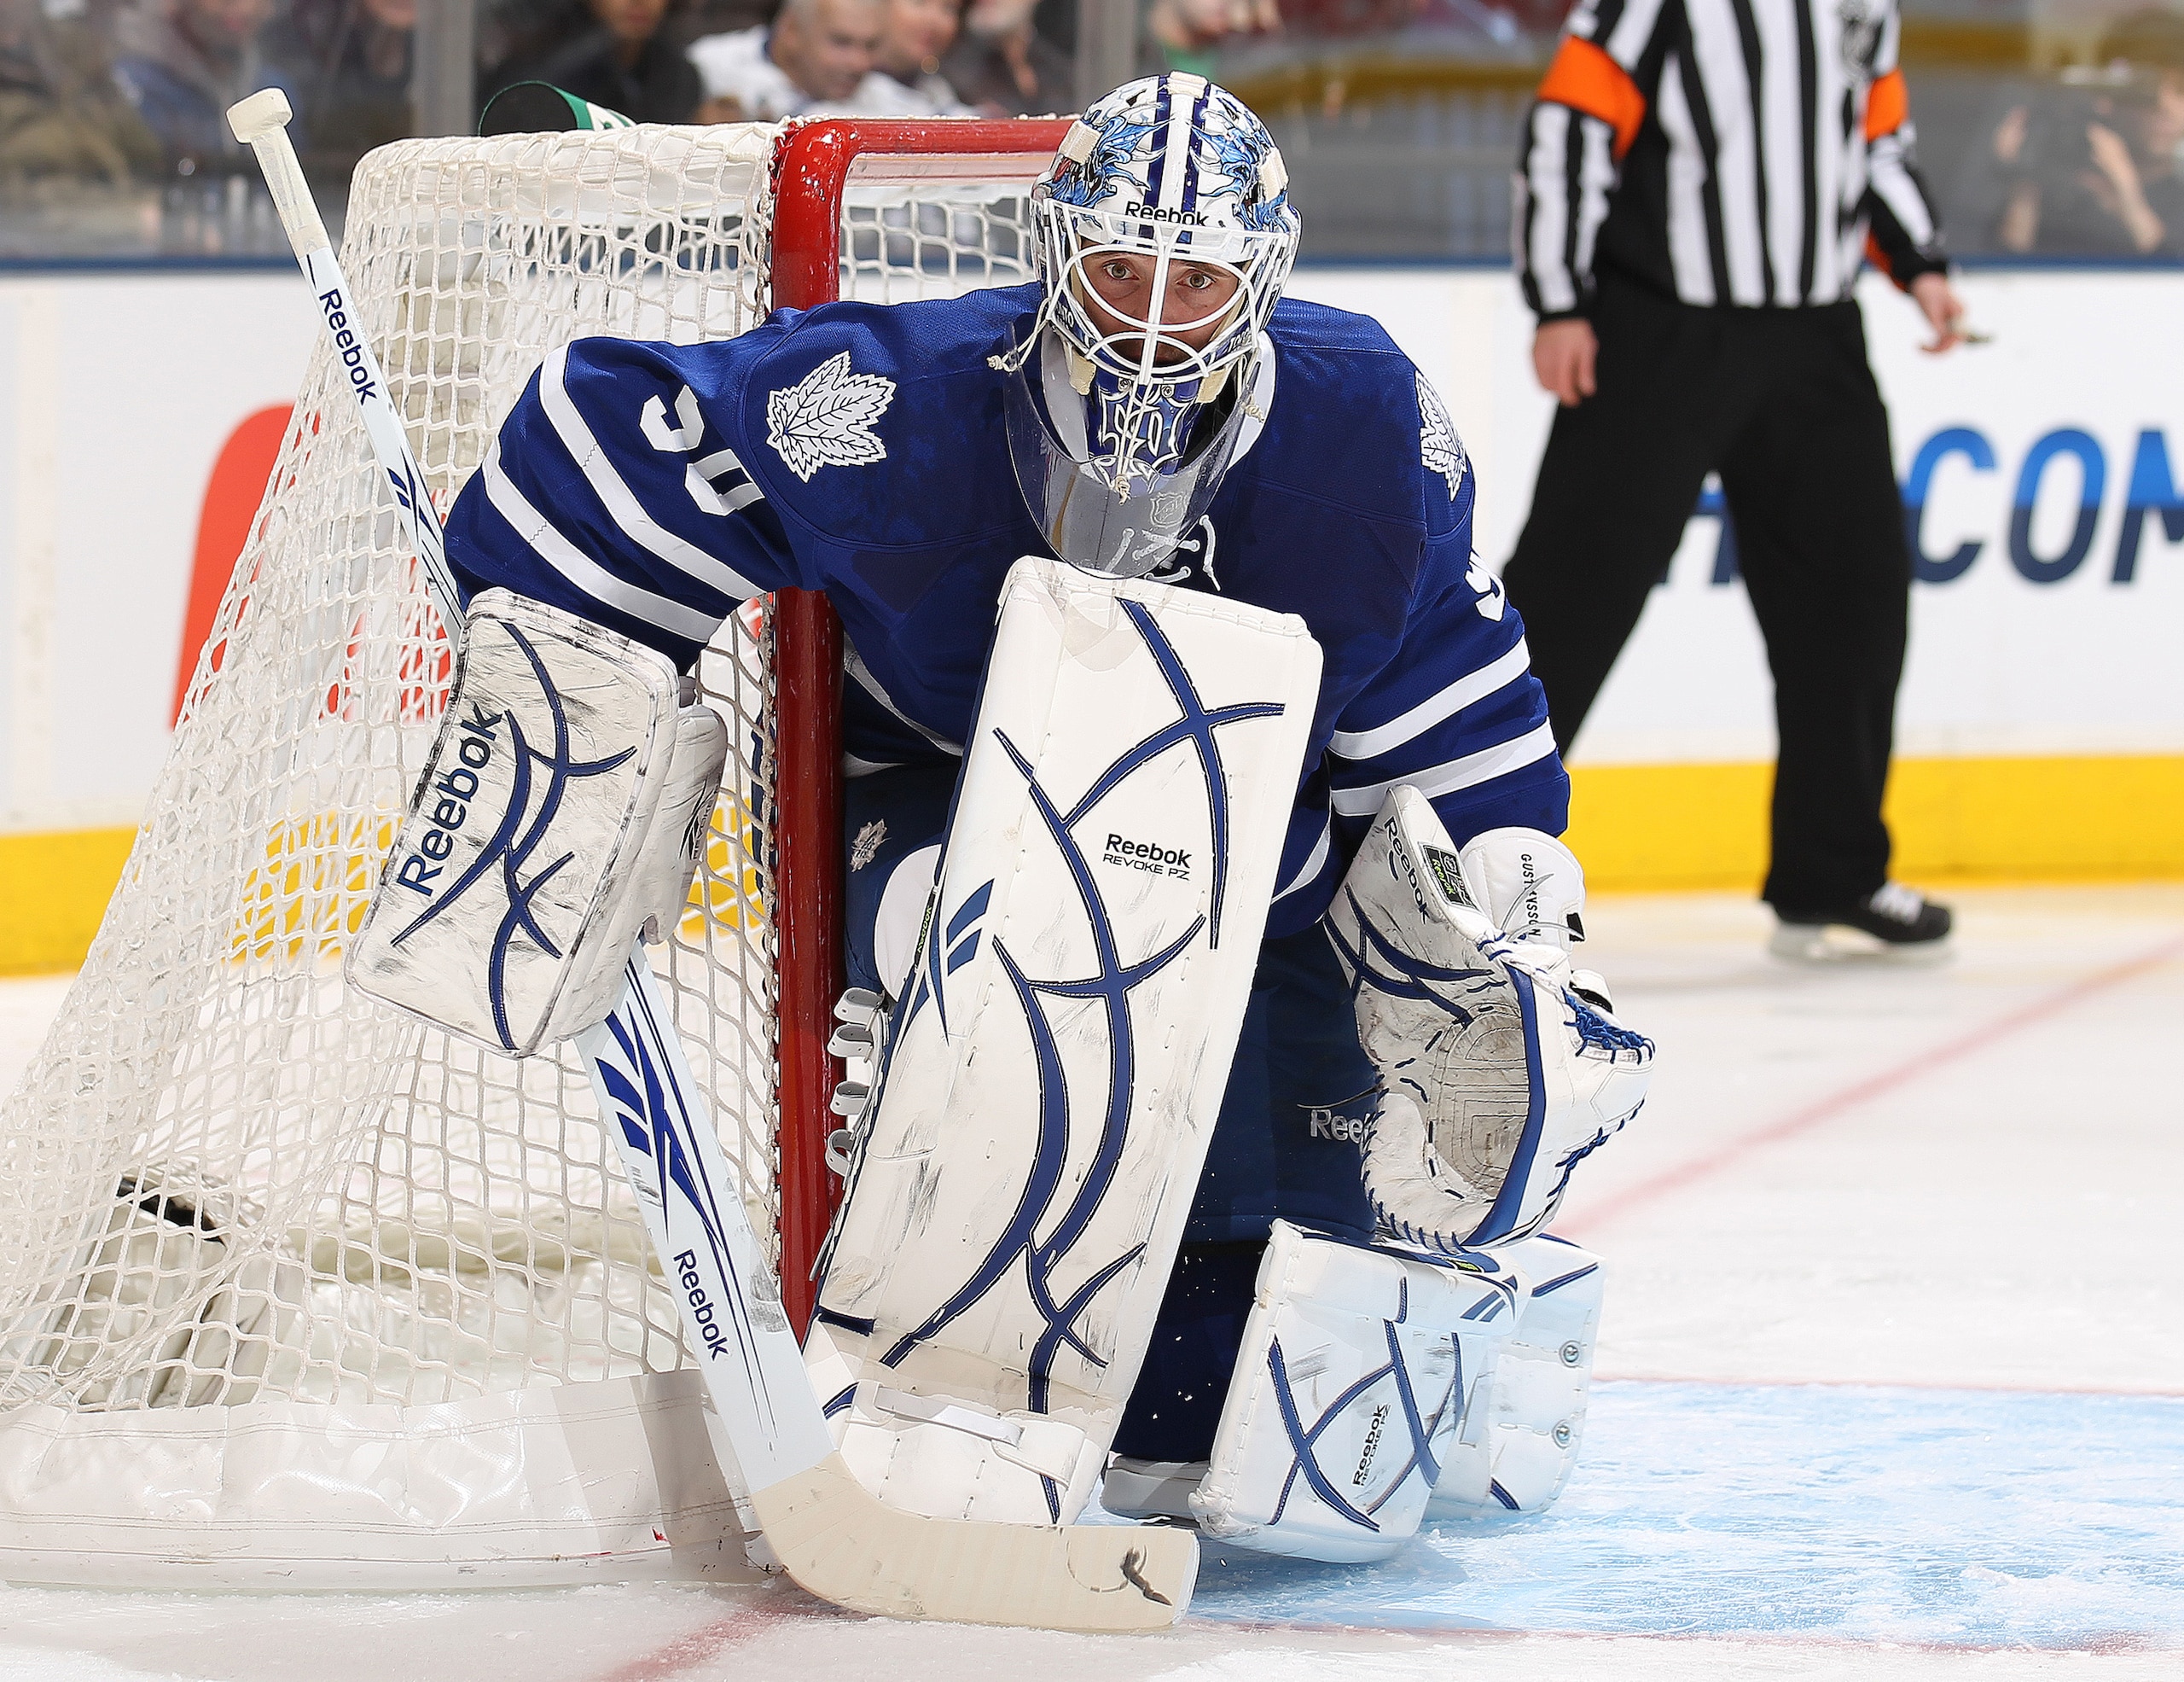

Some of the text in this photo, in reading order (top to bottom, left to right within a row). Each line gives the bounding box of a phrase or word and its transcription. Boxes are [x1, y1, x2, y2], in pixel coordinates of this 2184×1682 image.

[1125, 201, 1210, 226] Reebok
[318, 288, 378, 406] Reebok
[396, 701, 504, 896] Reebok
[1102, 853, 1190, 882] REVOKE PZ
[1106, 833, 1193, 869] Reebok
[1384, 816, 1432, 925] Reebok
[672, 1248, 729, 1362] Reebok
[1352, 1404, 1386, 1486] Reebok
